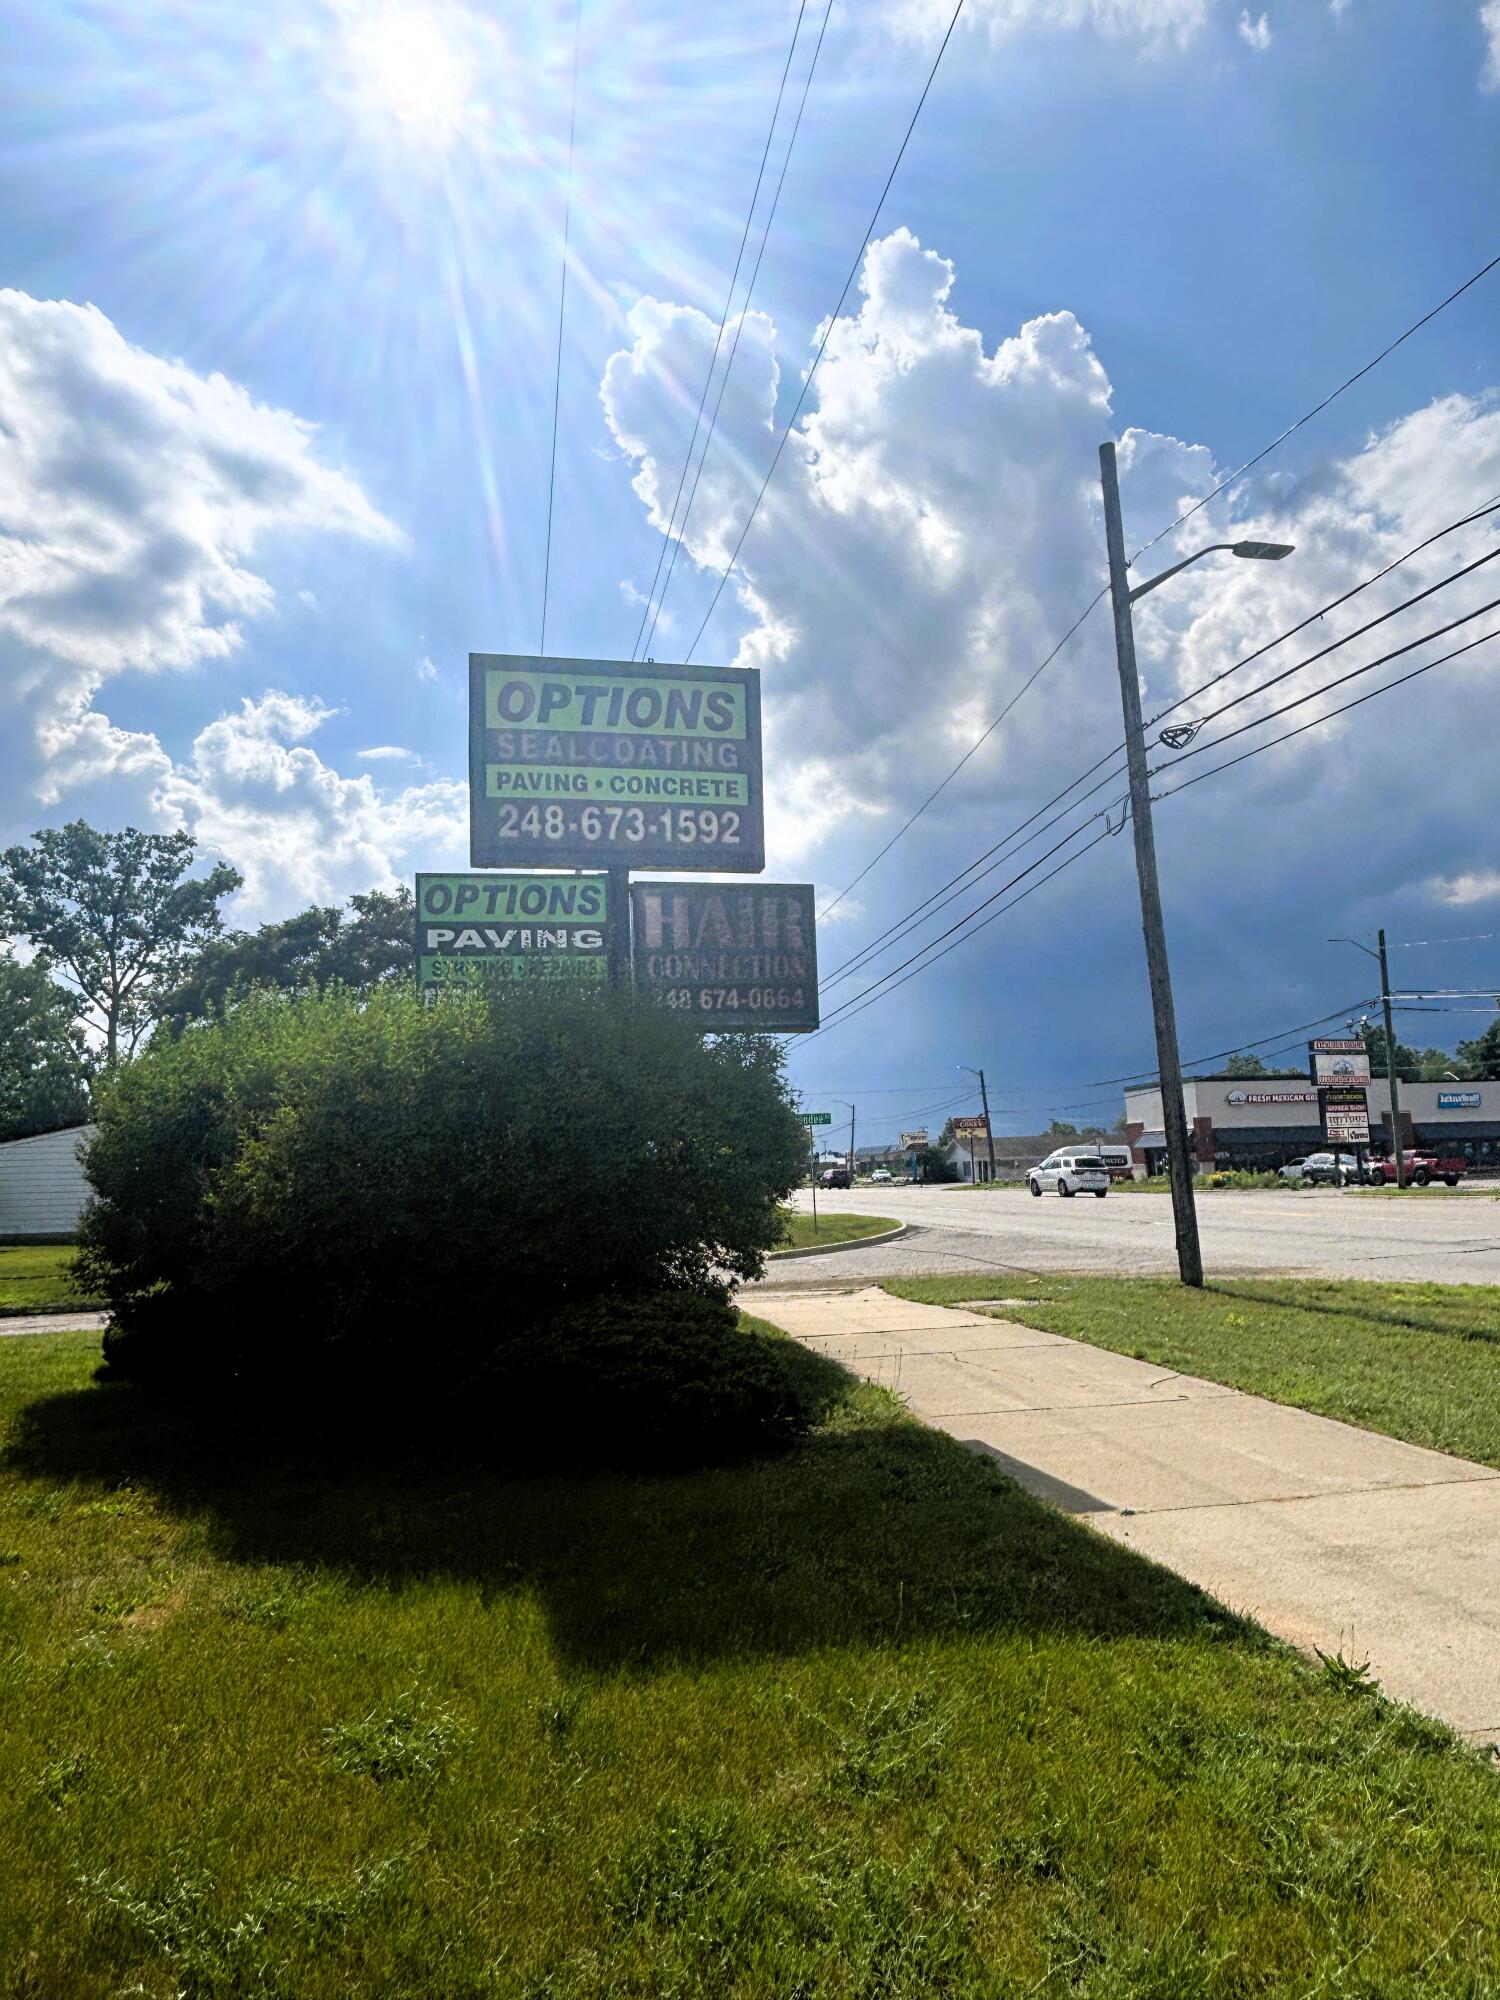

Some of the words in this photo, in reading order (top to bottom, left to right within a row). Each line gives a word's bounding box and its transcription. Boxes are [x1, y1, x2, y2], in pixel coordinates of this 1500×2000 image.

[497, 680, 736, 732] OPTIONS
[498, 732, 739, 769] SEALCOATING
[496, 772, 589, 793] PAVING
[609, 775, 740, 798] CONCRETE
[499, 804, 741, 845] 248-673-1592
[424, 883, 602, 916] OPTIONS
[427, 929, 603, 949] PAVING
[1272, 1094, 1304, 1102] MEXICAN
